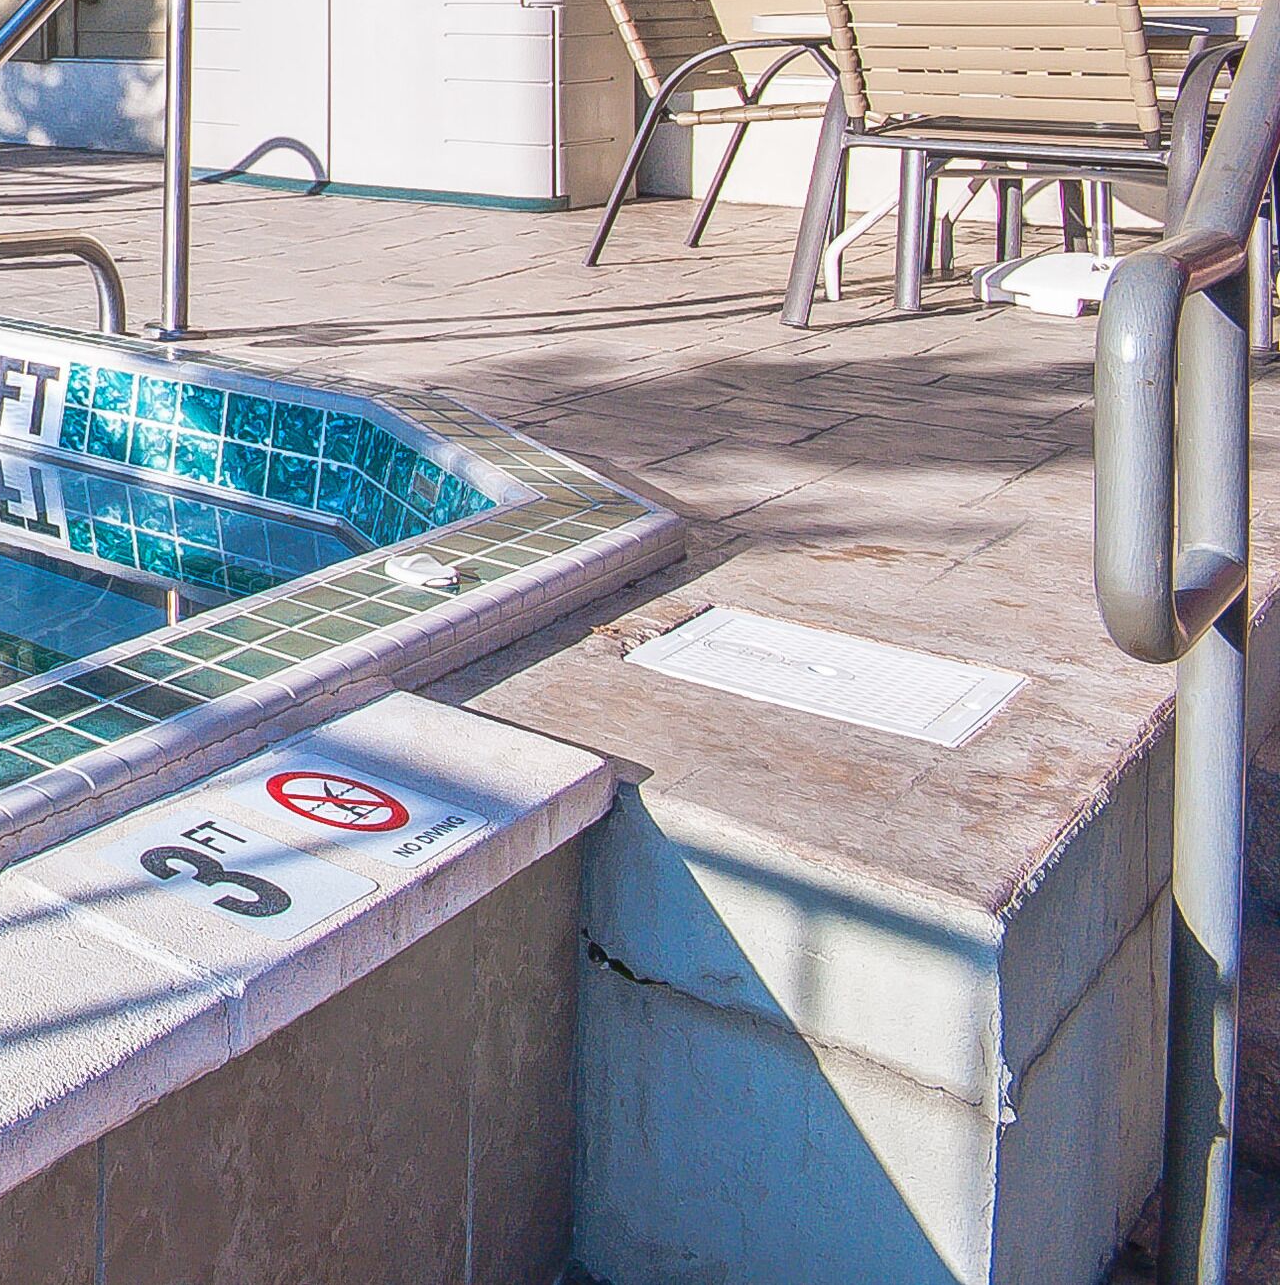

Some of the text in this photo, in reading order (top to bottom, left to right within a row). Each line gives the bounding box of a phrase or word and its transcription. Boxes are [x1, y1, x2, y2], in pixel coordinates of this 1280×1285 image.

[139, 820, 292, 918] 3 FT
[392, 815, 468, 858] NO DIVING
